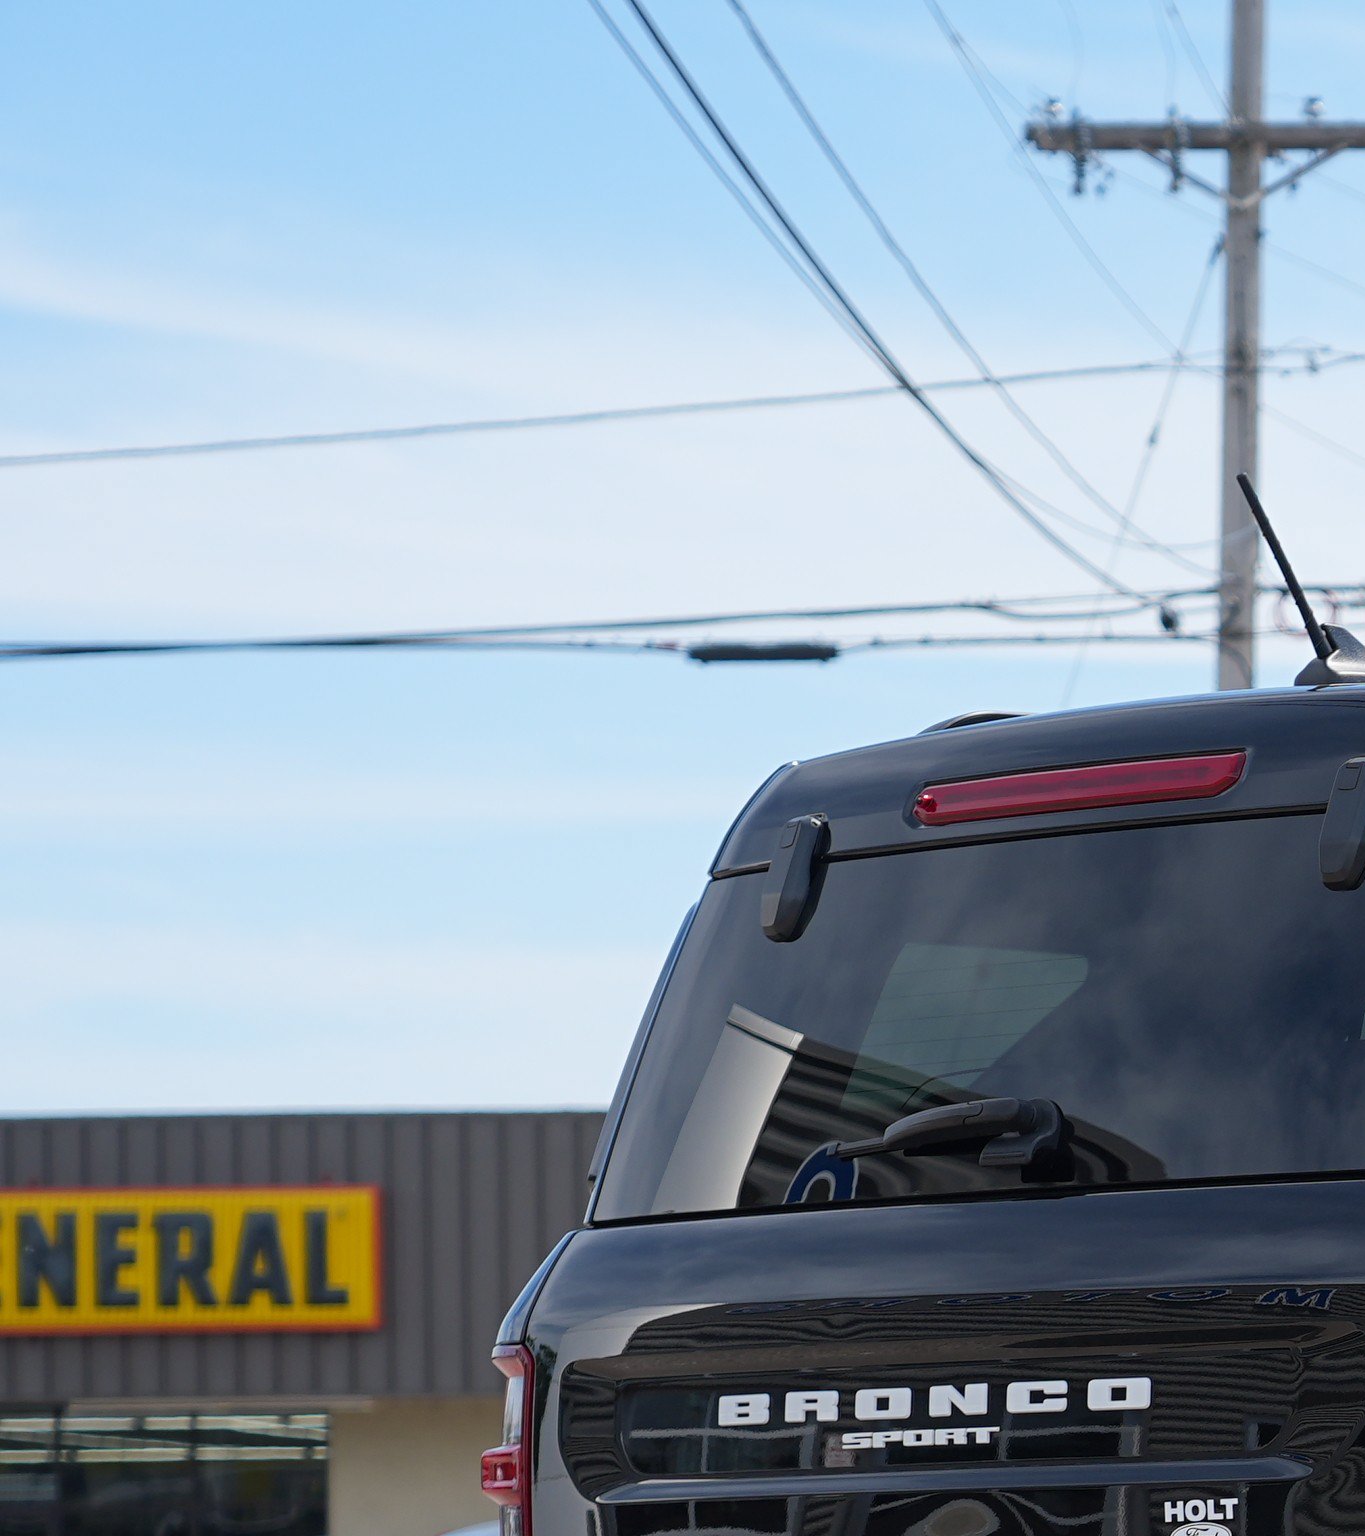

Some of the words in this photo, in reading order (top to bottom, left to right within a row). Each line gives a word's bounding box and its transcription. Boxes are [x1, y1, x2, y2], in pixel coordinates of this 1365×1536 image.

[0, 1210, 349, 1307] NERAL
[718, 1376, 1152, 1427] BRONCO
[842, 1426, 1000, 1449] SPORT
[1164, 1498, 1238, 1523] HOLT
